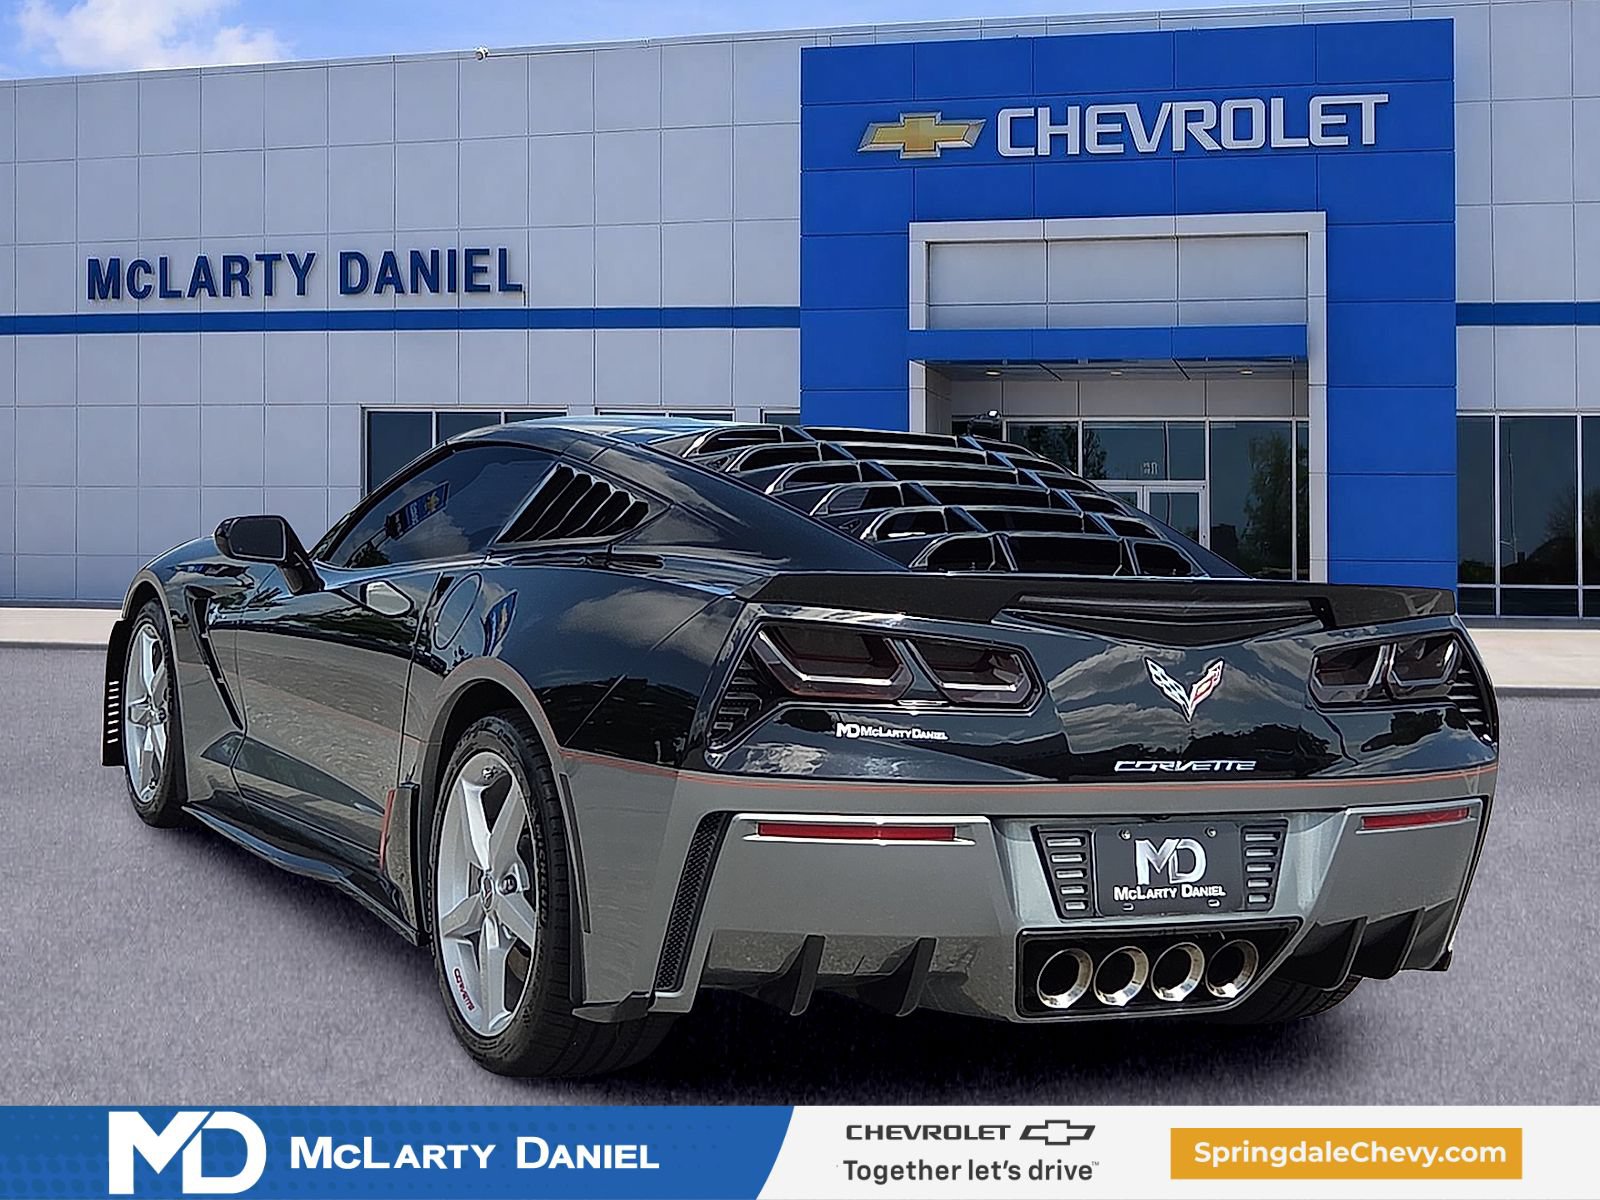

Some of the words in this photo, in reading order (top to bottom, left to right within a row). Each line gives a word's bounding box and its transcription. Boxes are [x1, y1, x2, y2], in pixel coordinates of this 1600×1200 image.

[997, 93, 1389, 157] CHEVROLET
[339, 248, 523, 295] DANIEL
[836, 722, 860, 738] MD
[1114, 760, 1257, 772] CORVETTE
[1135, 838, 1207, 885] MD
[1181, 883, 1227, 898] DANIEL
